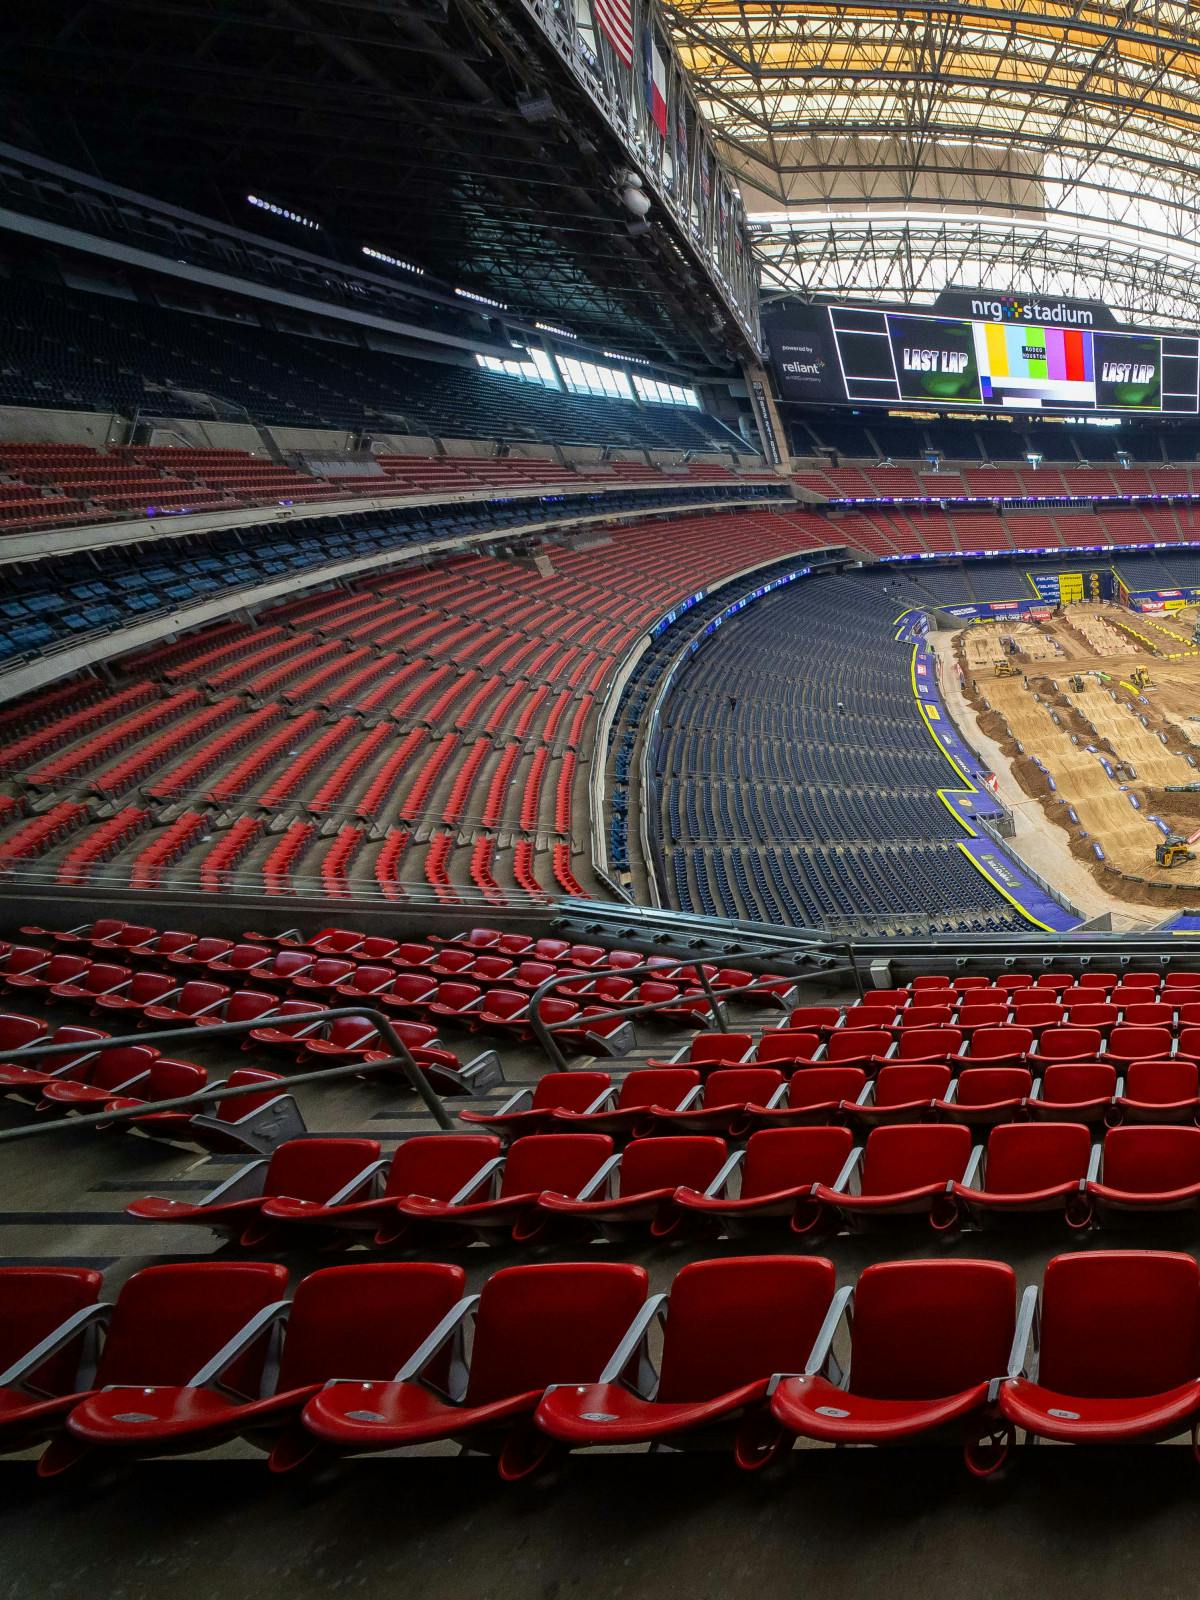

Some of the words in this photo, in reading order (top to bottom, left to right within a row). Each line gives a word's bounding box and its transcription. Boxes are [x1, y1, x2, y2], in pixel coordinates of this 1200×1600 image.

[971, 299, 1003, 322] nrg
[1023, 304, 1093, 324] stadium
[782, 361, 820, 374] reliant
[903, 348, 939, 372] LAST
[941, 351, 969, 374] LAP
[1101, 362, 1131, 382] LAST
[1131, 364, 1155, 384] LAP
